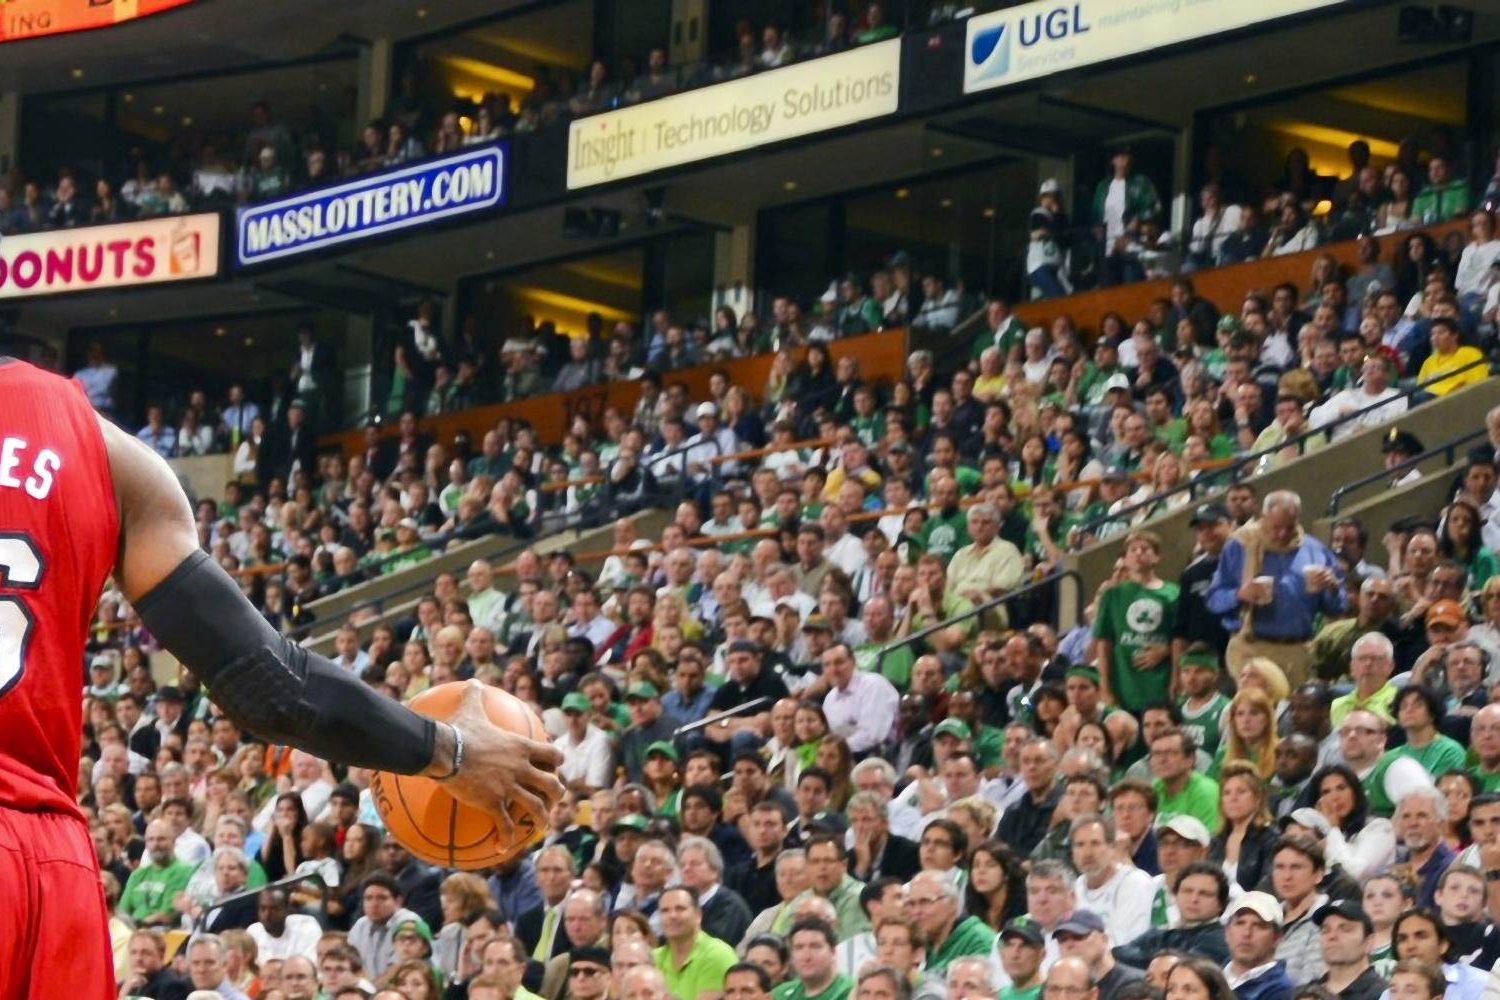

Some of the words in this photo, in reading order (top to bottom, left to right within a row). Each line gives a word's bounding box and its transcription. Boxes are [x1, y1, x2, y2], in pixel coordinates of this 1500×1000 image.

[1018, 2, 1091, 47] UGL
[574, 120, 636, 176] Insight
[653, 101, 776, 151] Technology
[782, 70, 894, 119] Solutions
[246, 159, 493, 254] MASSLOTTERY.COM
